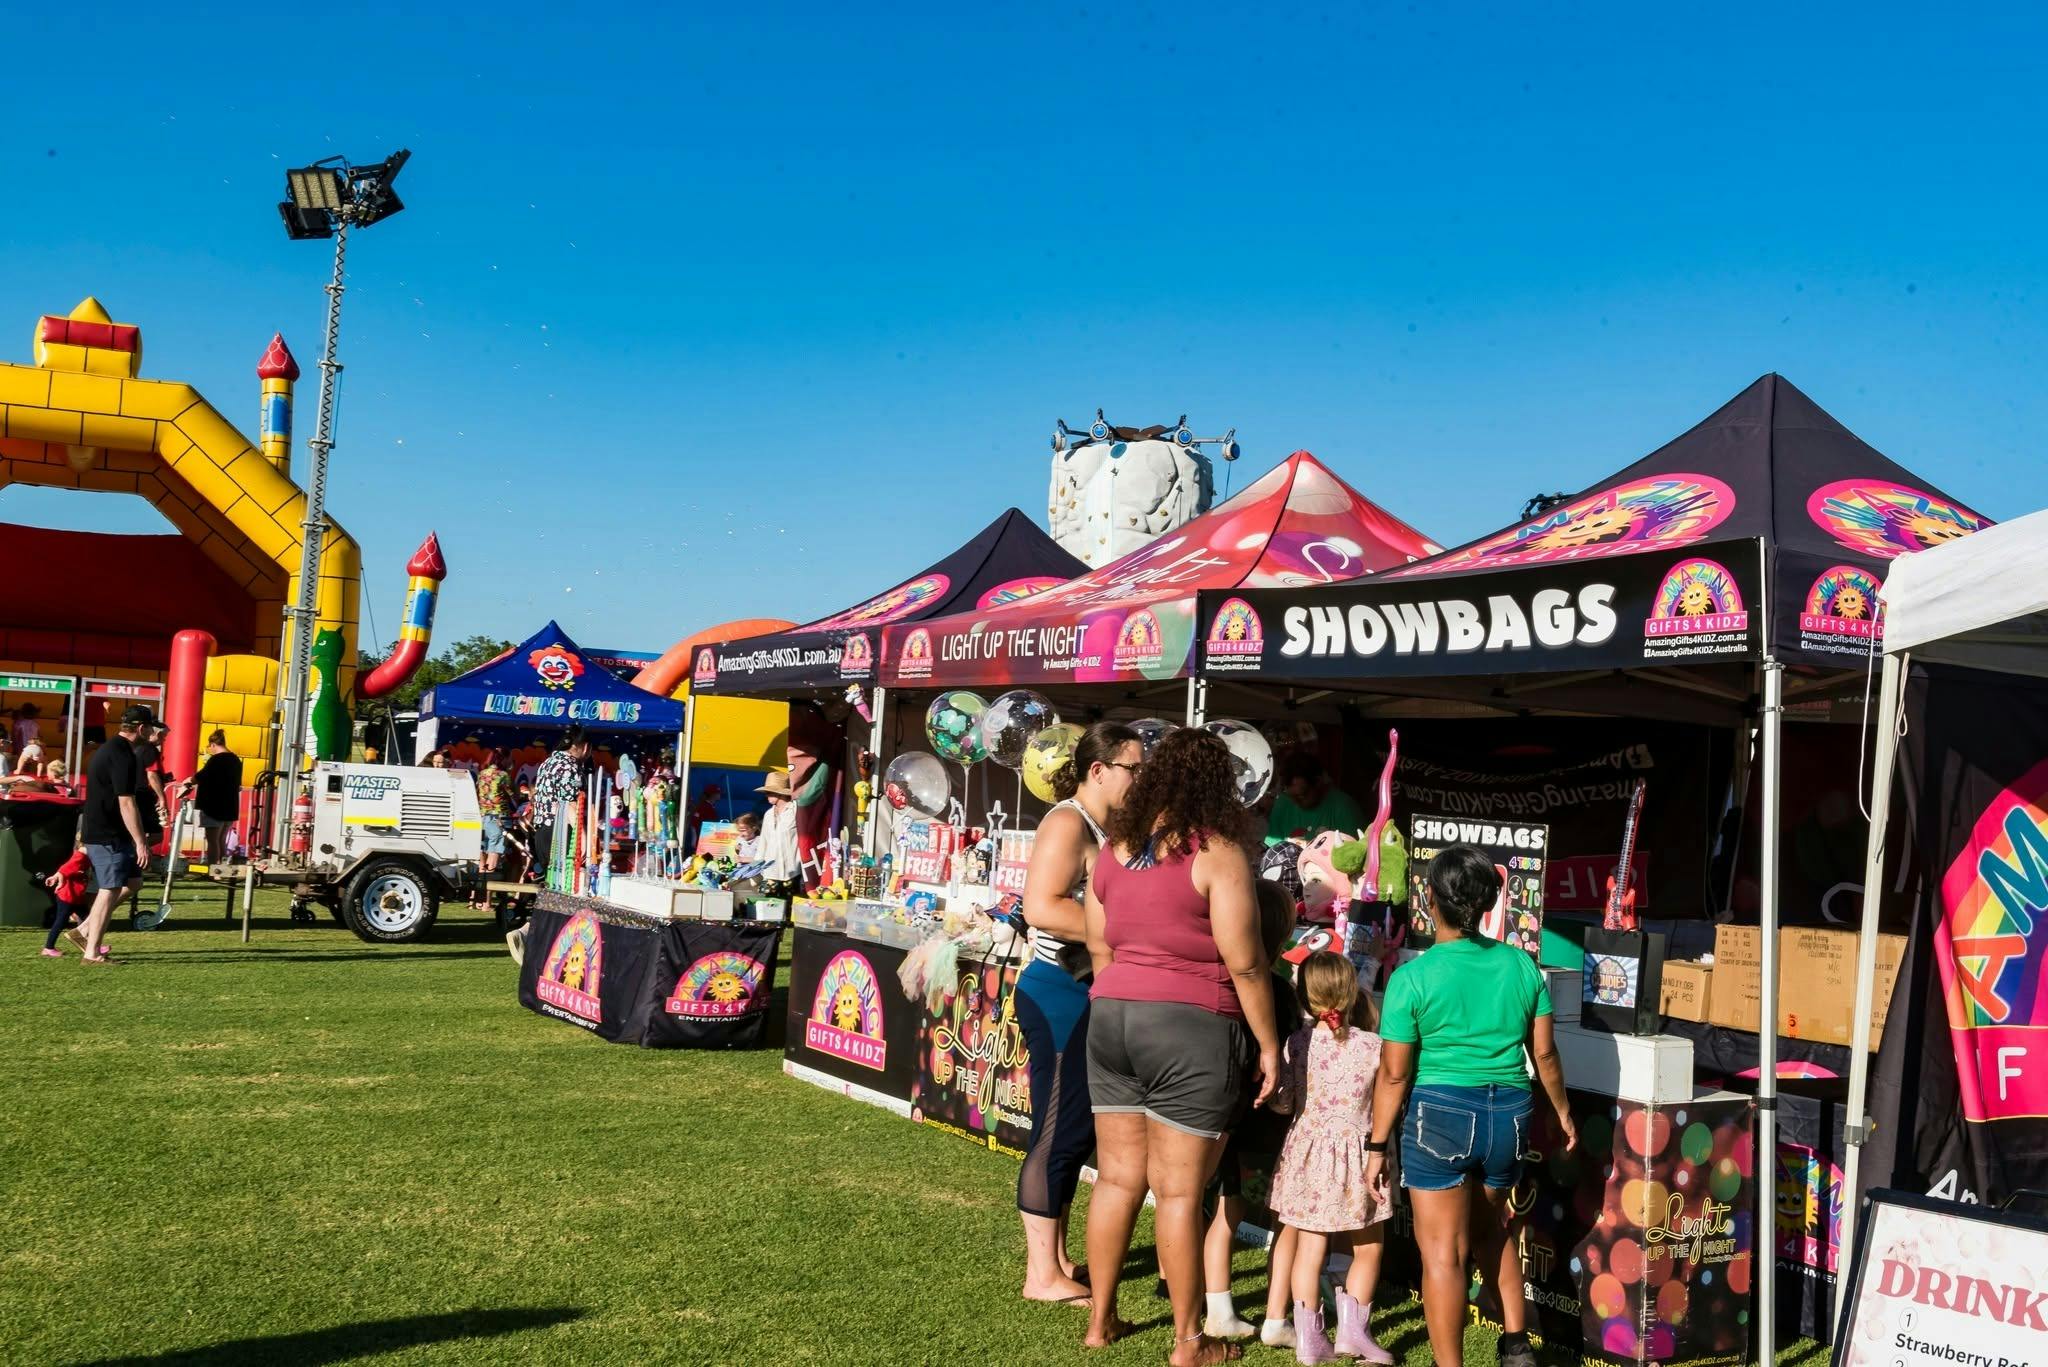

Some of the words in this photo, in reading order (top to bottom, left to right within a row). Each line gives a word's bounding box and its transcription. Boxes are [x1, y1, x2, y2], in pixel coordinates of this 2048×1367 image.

[1659, 563, 1738, 617] AMAZING
[1280, 583, 1618, 657] SHOWBAGS
[1649, 620, 1690, 634] GIFTS
[1693, 619, 1702, 631] 4
[1804, 616, 1846, 632] GIFTS
[1850, 622, 1857, 633] 4
[941, 632, 983, 661] LIGHT
[983, 631, 1004, 659] UP
[1007, 629, 1035, 657] THE
[1038, 625, 1089, 656] NIGHT
[1208, 642, 1230, 653] GIFTS
[1644, 632, 1747, 646] AmazingGifts4KIDZ.com.au
[616, 659, 640, 668] SLIDE
[717, 647, 842, 674] AmazingGifts4KIDZ.com.au
[8, 677, 58, 689] ENTRY
[107, 684, 141, 695] EXIT
[484, 693, 566, 717] LAUGHING
[568, 698, 642, 723] CLOWNS
[345, 775, 400, 790] MASTER
[352, 788, 384, 800] HIRE
[1413, 820, 1545, 849] SHOWBAGS
[1414, 847, 1420, 859] 8
[1509, 856, 1517, 869] 4
[1517, 857, 1542, 871] TOYS
[539, 982, 565, 1005] GIFTS
[566, 992, 573, 1008] 4
[816, 956, 881, 1033] AMAZING
[1670, 990, 1678, 999] 24
[1682, 992, 1694, 1003] PCS
[671, 1000, 720, 1013] GIFTS
[725, 999, 733, 1012] 4
[809, 1027, 841, 1050] GIFTS
[843, 1037, 850, 1053] 4
[934, 1057, 952, 1086] UP
[955, 1066, 979, 1097] THE
[1645, 1192, 1732, 1266] Light
[1647, 1246, 1665, 1261] UP
[1668, 1243, 1690, 1259] THE
[1702, 1239, 1737, 1256] NIGHT
[1783, 1239, 1797, 1257] 4
[1545, 1291, 1556, 1307] 4
[1555, 1294, 1581, 1317] KIDZ
[1876, 1259, 2048, 1332] DRINK
[1905, 1313, 1912, 1328] 1
[1895, 1333, 1992, 1367] Strawberry
